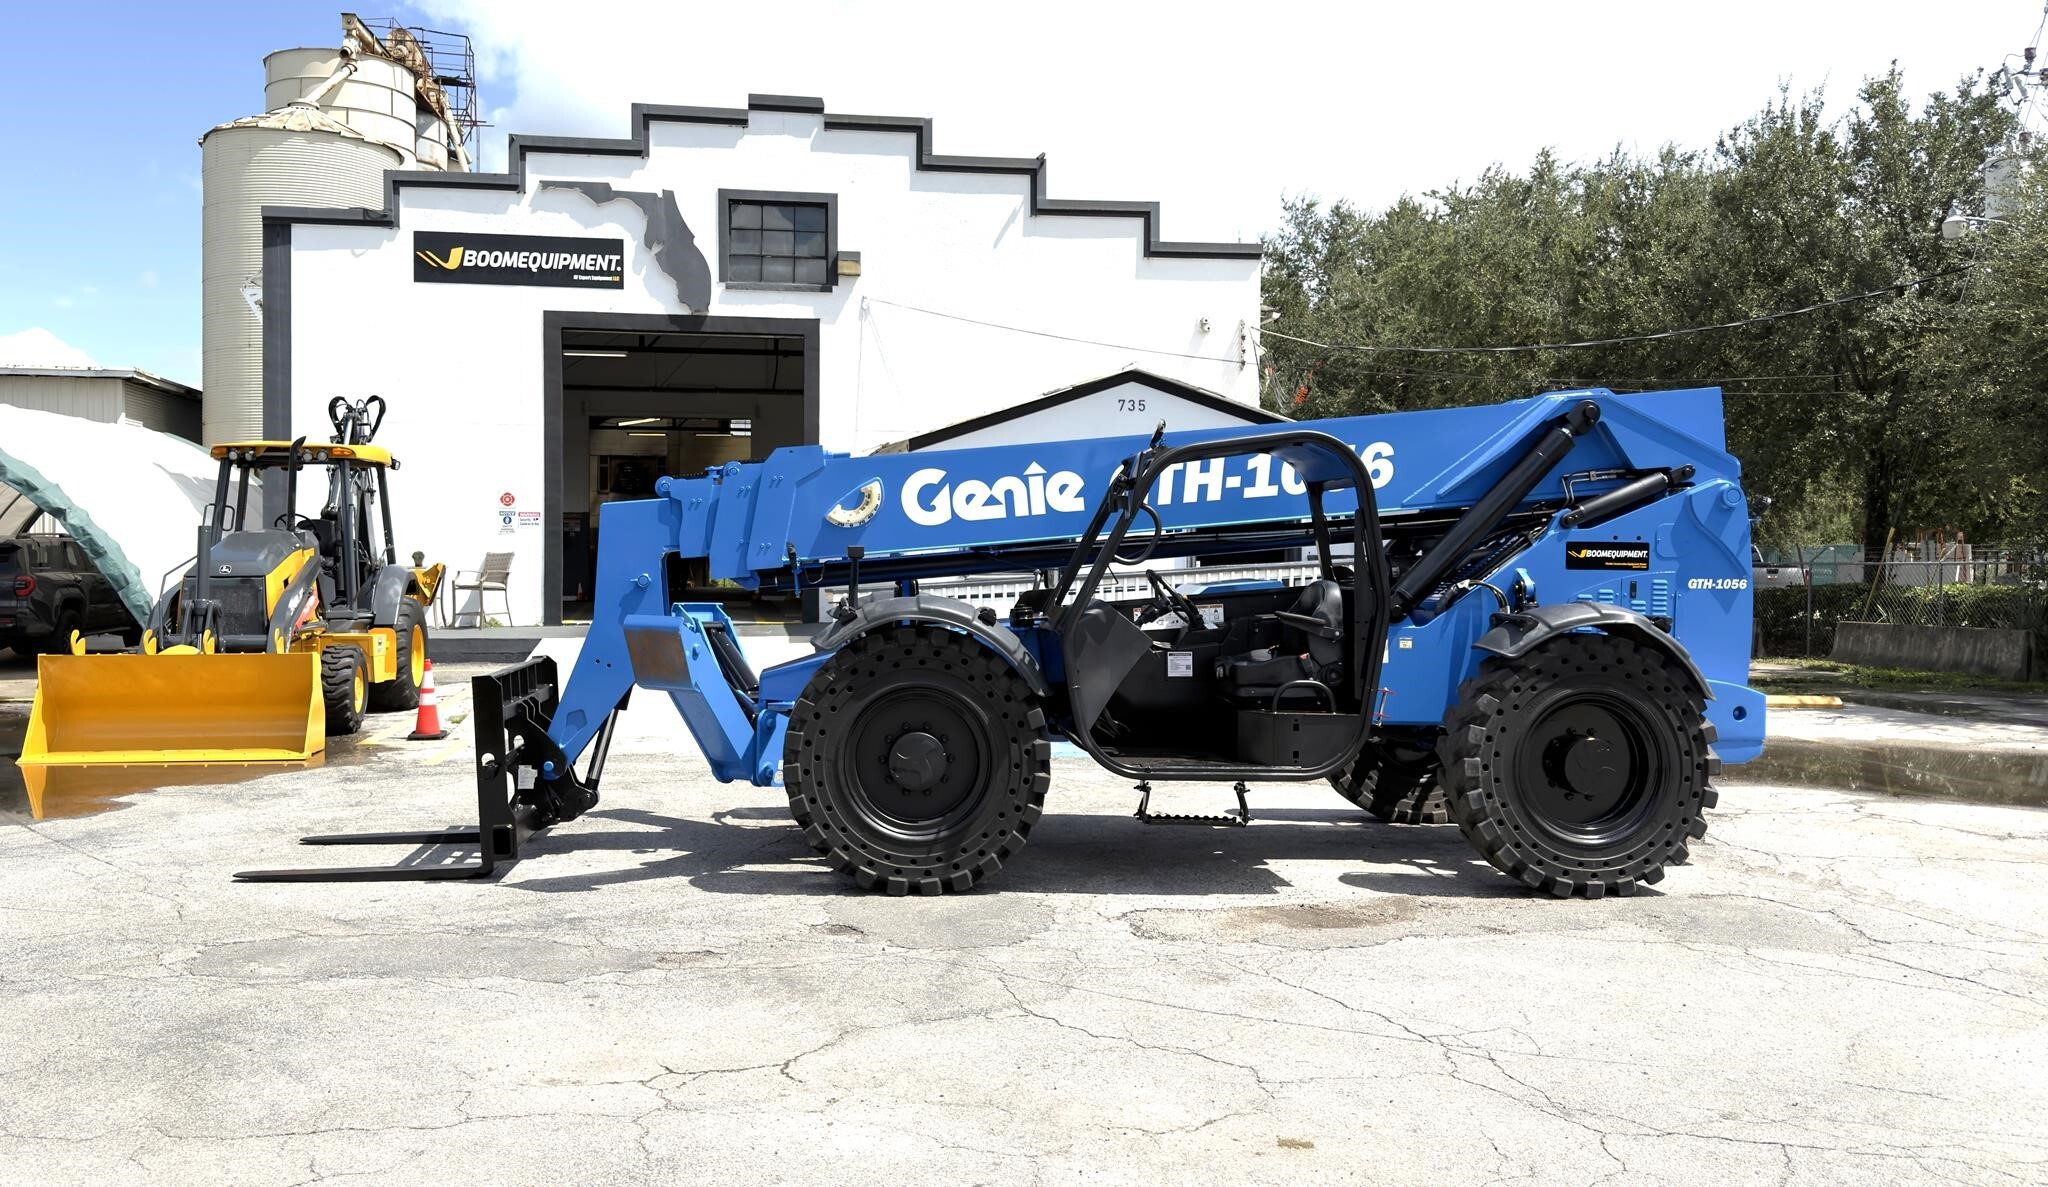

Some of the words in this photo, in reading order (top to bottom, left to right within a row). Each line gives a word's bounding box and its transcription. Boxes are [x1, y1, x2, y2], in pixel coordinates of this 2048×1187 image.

[1118, 399, 1146, 412] 735
[901, 461, 1086, 527] Genie
[1687, 578, 1748, 590] GTH-1056
